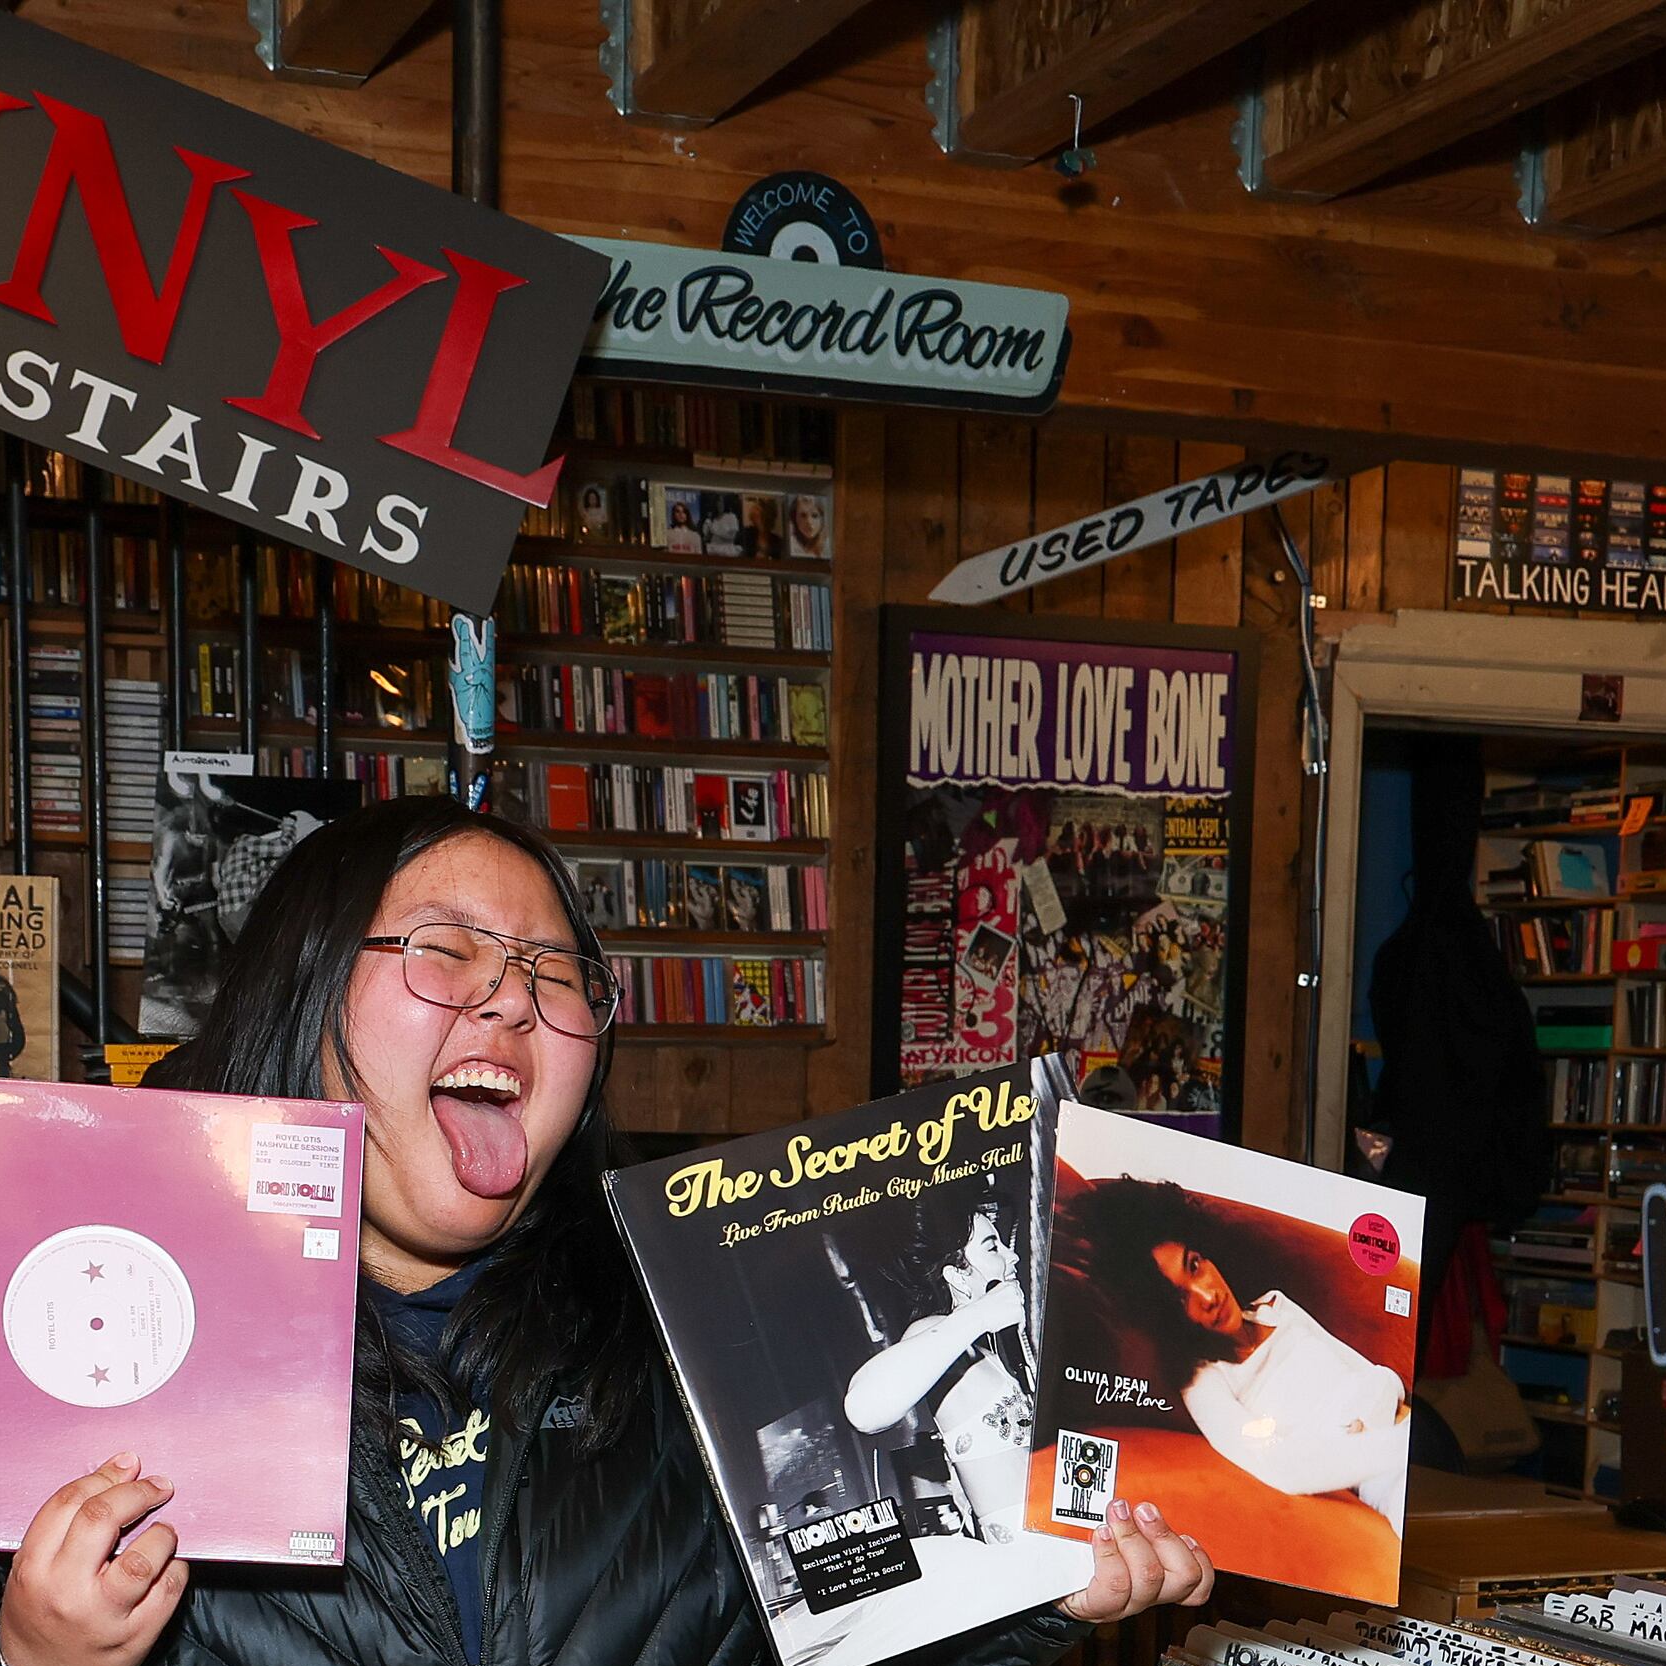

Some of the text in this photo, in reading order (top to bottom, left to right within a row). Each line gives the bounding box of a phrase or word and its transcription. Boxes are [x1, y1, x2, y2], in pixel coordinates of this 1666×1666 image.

[733, 182, 868, 254] WELCOME TO
[593, 260, 1044, 373] he Record Room
[1000, 451, 1329, 586] USED TAPES
[1457, 558, 1590, 605] TALKING
[910, 653, 1229, 789] MOTHER LOVE BONE
[665, 1080, 1038, 1217] The Secret of Us
[719, 1142, 1025, 1248] Live From Radio City Music Hall
[1065, 1367, 1149, 1393] OLIVIA DEAN
[1061, 1435, 1114, 1469] RECORD
[1063, 1461, 1108, 1493] STORE
[1071, 1486, 1093, 1512] DAY
[291, 1539, 335, 1550] ADVISORY
[788, 1499, 899, 1554] RECORD STORE DAY
[802, 1532, 902, 1571] Exclusive Vinyl Includes
[852, 1565, 867, 1575] and
[855, 1555, 865, 1564] So
[829, 1582, 848, 1593] Love
